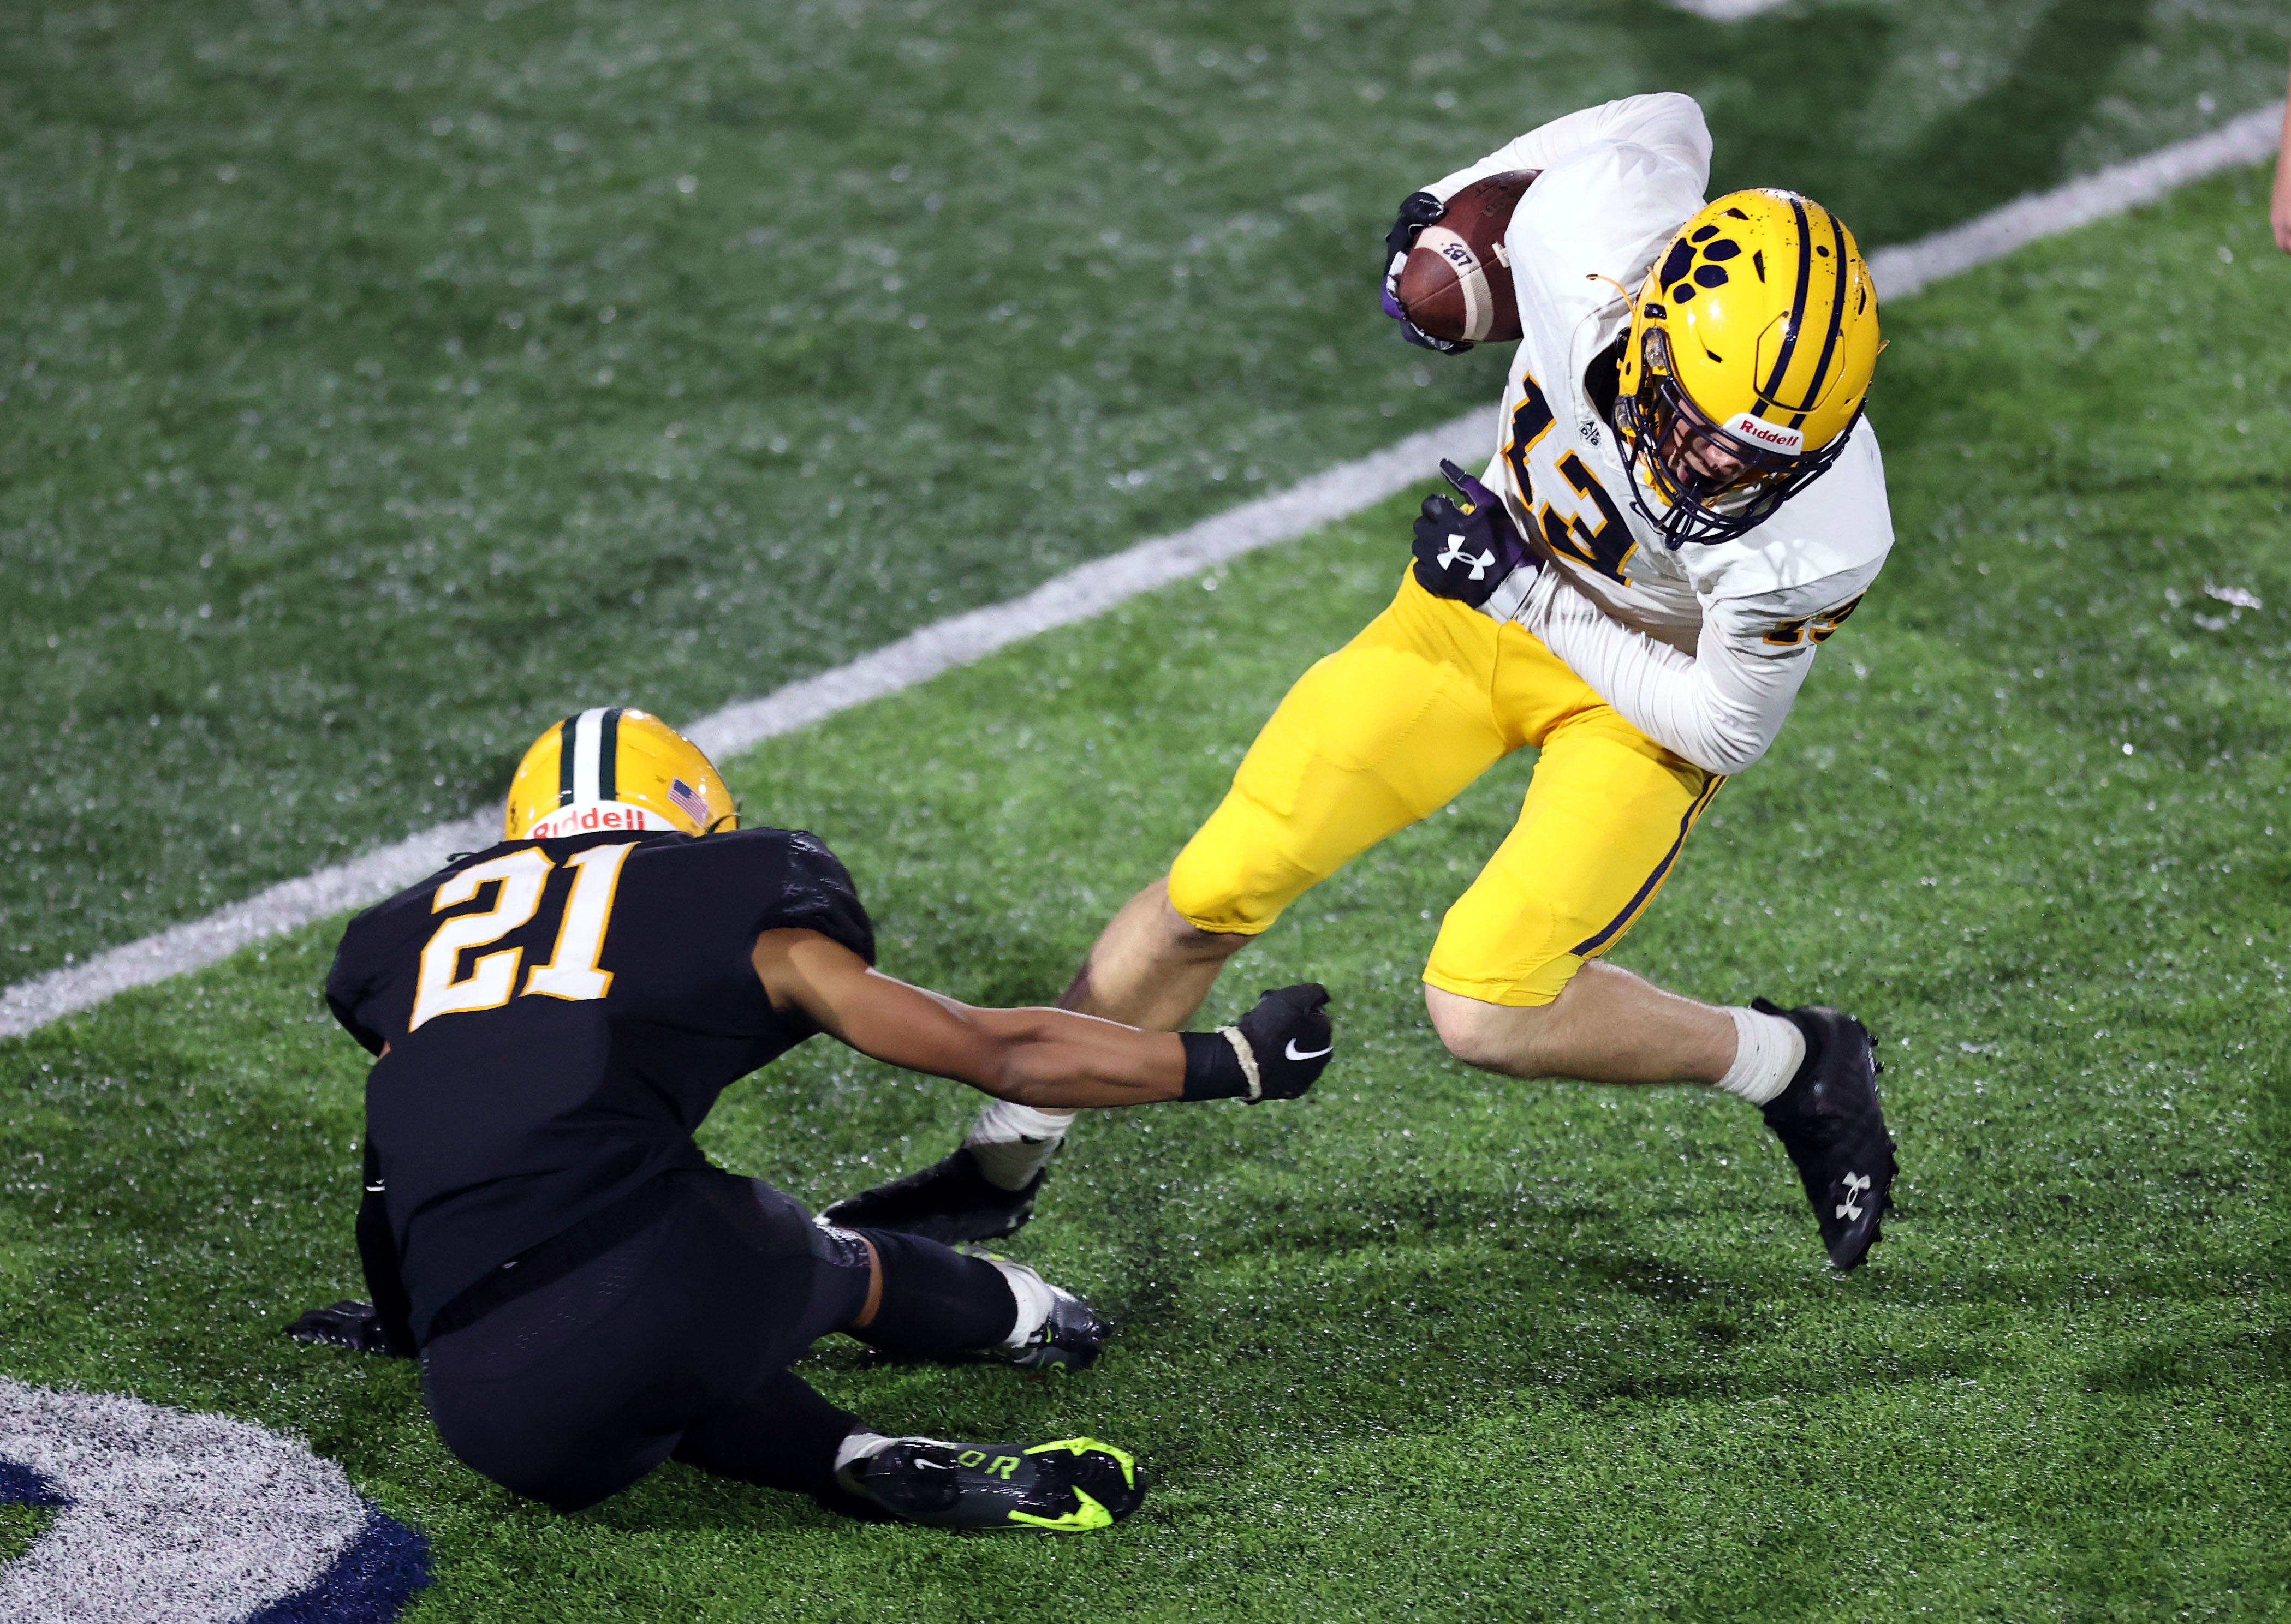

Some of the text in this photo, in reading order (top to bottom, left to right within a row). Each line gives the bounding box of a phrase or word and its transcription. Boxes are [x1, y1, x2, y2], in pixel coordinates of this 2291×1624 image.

[1501, 370, 1639, 587] 13
[1740, 420, 1799, 446] Riddell
[533, 808, 645, 839] Riddell
[408, 841, 642, 1034] 21
